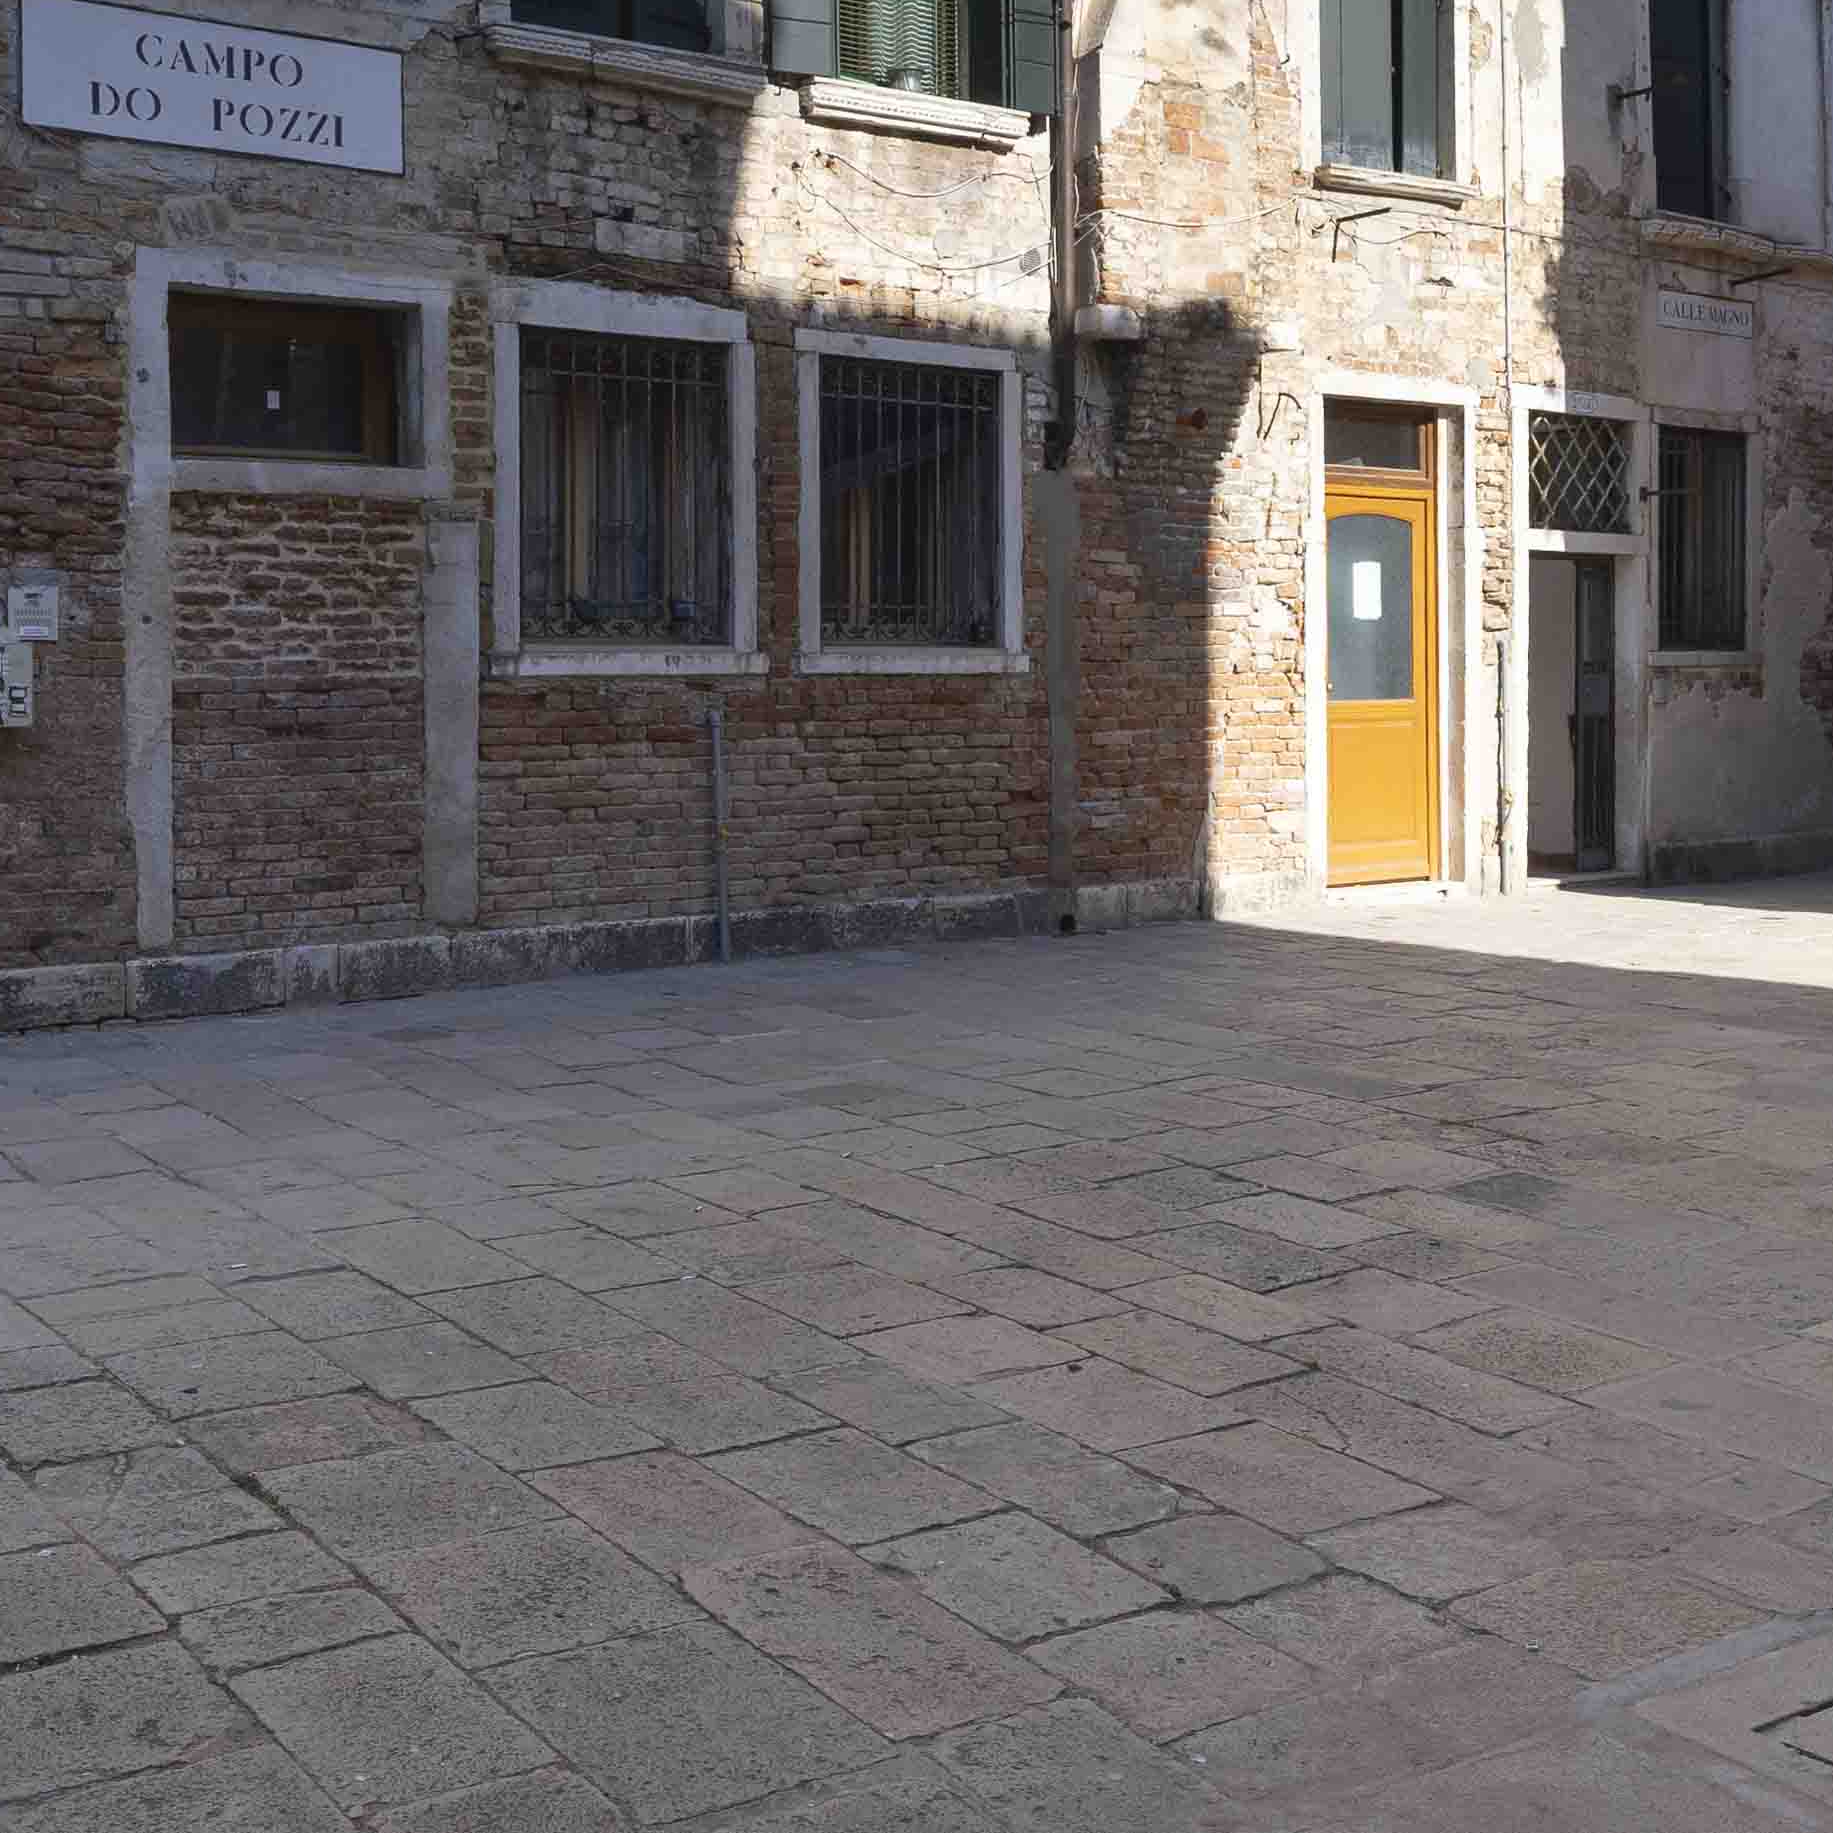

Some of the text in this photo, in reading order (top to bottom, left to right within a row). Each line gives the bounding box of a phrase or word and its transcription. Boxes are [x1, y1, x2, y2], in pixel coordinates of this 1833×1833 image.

[135, 33, 303, 88] CAMPO
[90, 81, 345, 148] DO POZZI
[1663, 300, 1750, 326] CALLE MAGNO
